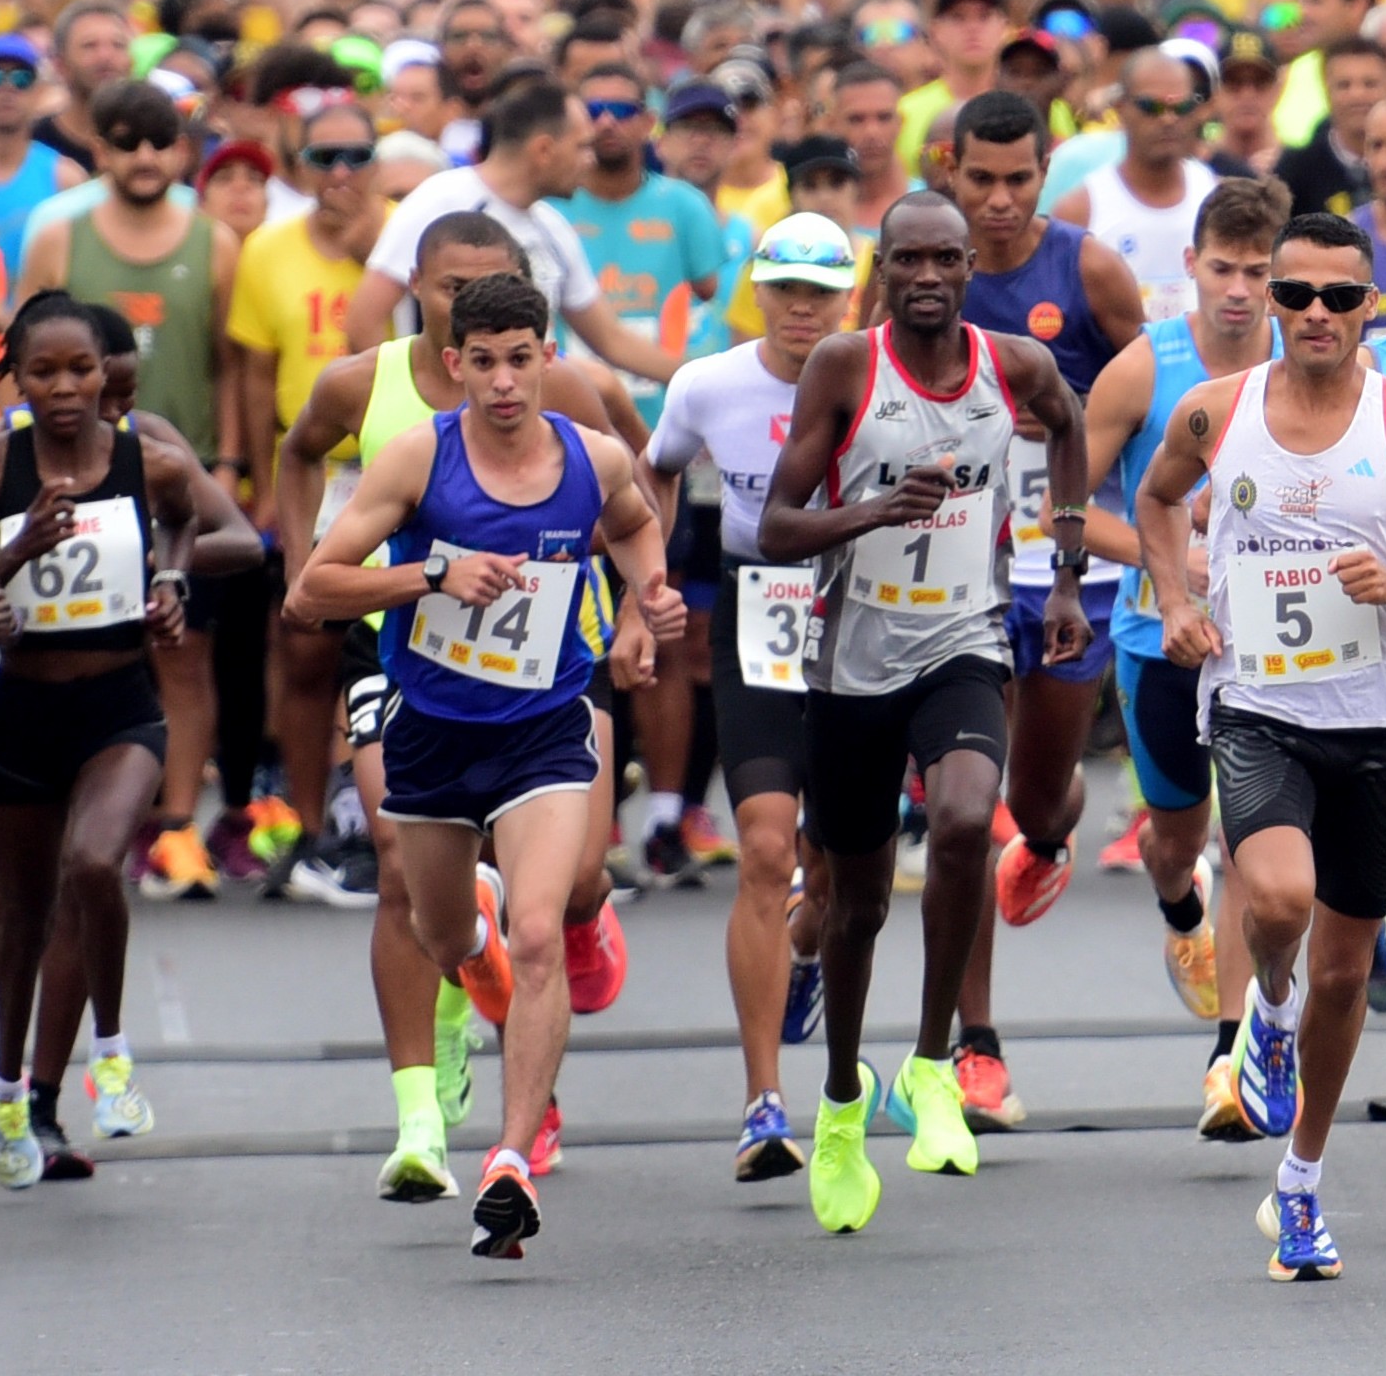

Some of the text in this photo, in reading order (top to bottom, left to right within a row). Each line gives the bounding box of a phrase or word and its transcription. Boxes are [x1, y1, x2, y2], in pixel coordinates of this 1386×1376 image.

[30, 541, 103, 598] 62
[903, 533, 932, 583] 1
[1264, 567, 1322, 588] FABIO
[763, 582, 813, 600] JONA
[460, 597, 533, 652] 14
[1275, 591, 1313, 648] 5
